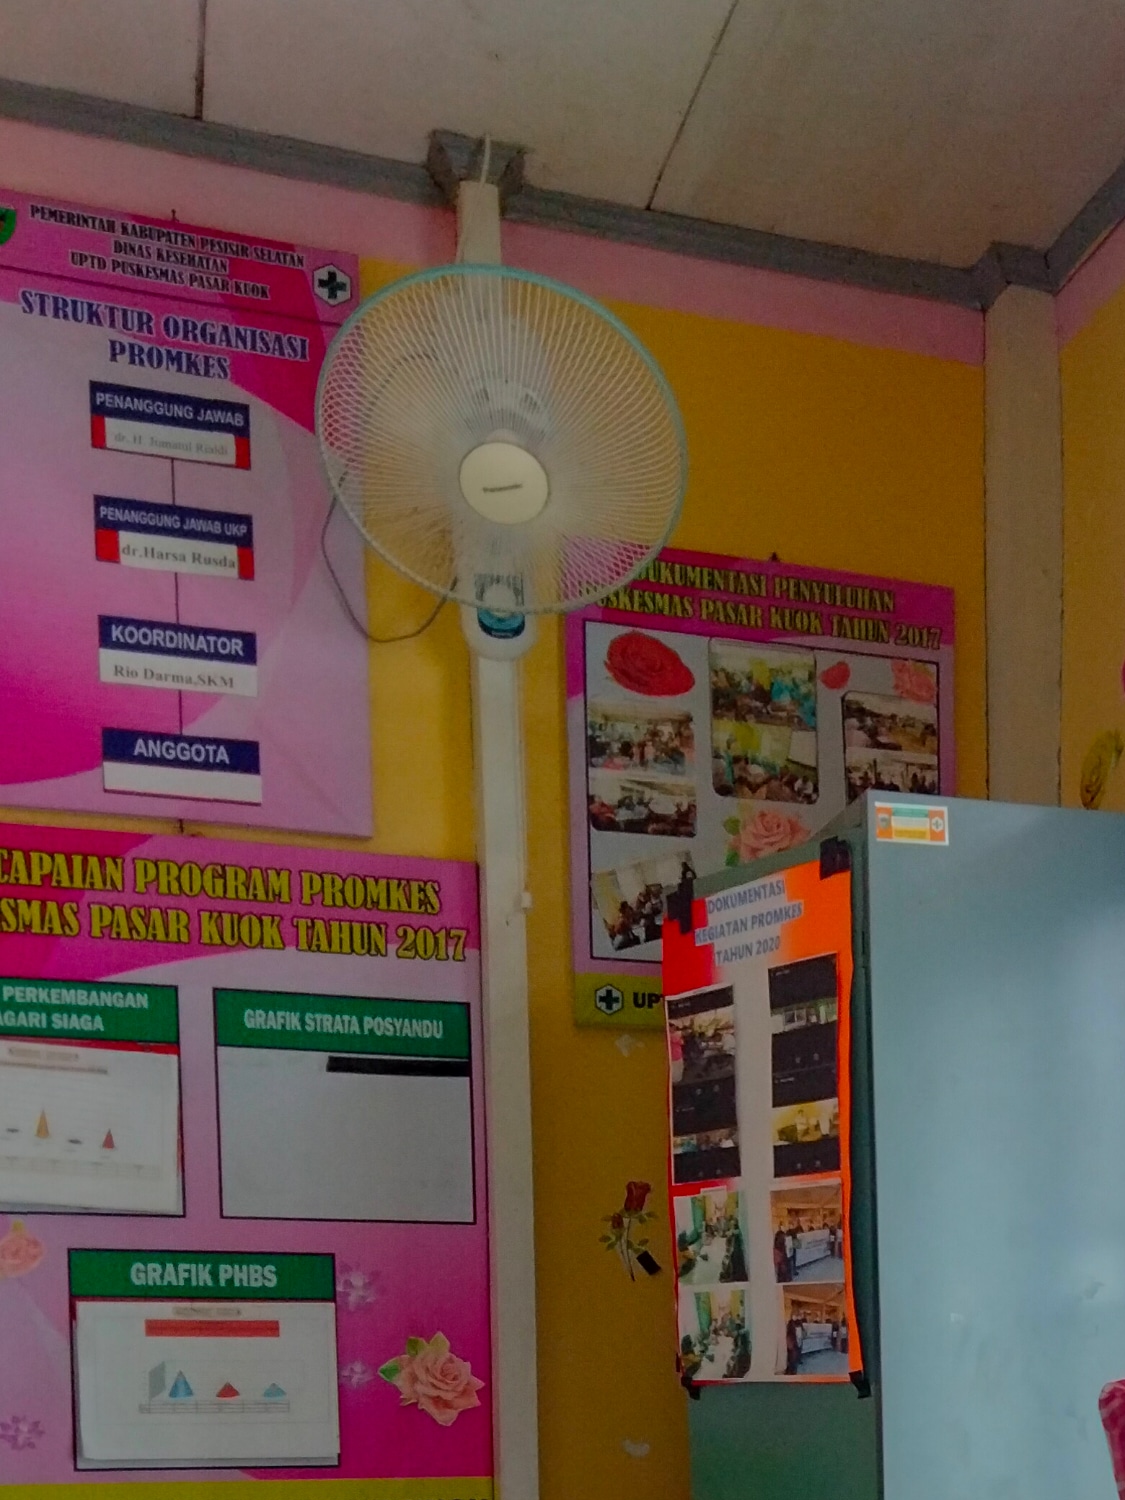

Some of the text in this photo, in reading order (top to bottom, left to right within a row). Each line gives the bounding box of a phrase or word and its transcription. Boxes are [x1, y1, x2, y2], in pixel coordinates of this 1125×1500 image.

[30, 204, 305, 268] PEMERINTAH KABUPATEN PESISIR SELATAN
[113, 239, 228, 274] DINAS KESEHATAN
[70, 251, 270, 299] UPTD PUSKESMAS PASAR KUOK
[19, 289, 310, 362] STRUKTUR ORGANISASI
[108, 338, 231, 380] PROMKES
[95, 392, 244, 427] PENANGGUNG JAWAB
[99, 505, 248, 538] PENANGGUNG JAWAB UKP
[191, 551, 236, 570] Rusda
[773, 575, 894, 612] PENYULUHAN
[111, 624, 244, 656] KOORDINATOR
[700, 598, 762, 628] PASAR
[769, 606, 823, 635] KUOK
[830, 614, 889, 643] TAHUN
[895, 623, 941, 650] 2017
[113, 663, 138, 680] Rio
[133, 737, 230, 765] ANGGOTA
[134, 858, 292, 905] PROGRAM
[301, 871, 442, 915] PROMKES
[708, 878, 786, 914] DOKUMENTASI
[90, 903, 191, 943] PASAR
[200, 910, 285, 950] KUOK
[293, 917, 388, 956] TAHUN
[395, 926, 468, 962] 2017
[696, 902, 802, 944] KEGIATAN PROMKES
[716, 935, 780, 965] TAHUN 2020
[3, 985, 149, 1009] PERKEMBANGAN
[52, 1013, 104, 1032] SIAGA
[244, 1009, 444, 1039] GRAFIK STRATA POSYANDU
[130, 1262, 278, 1288] GRAFIK PHBS
